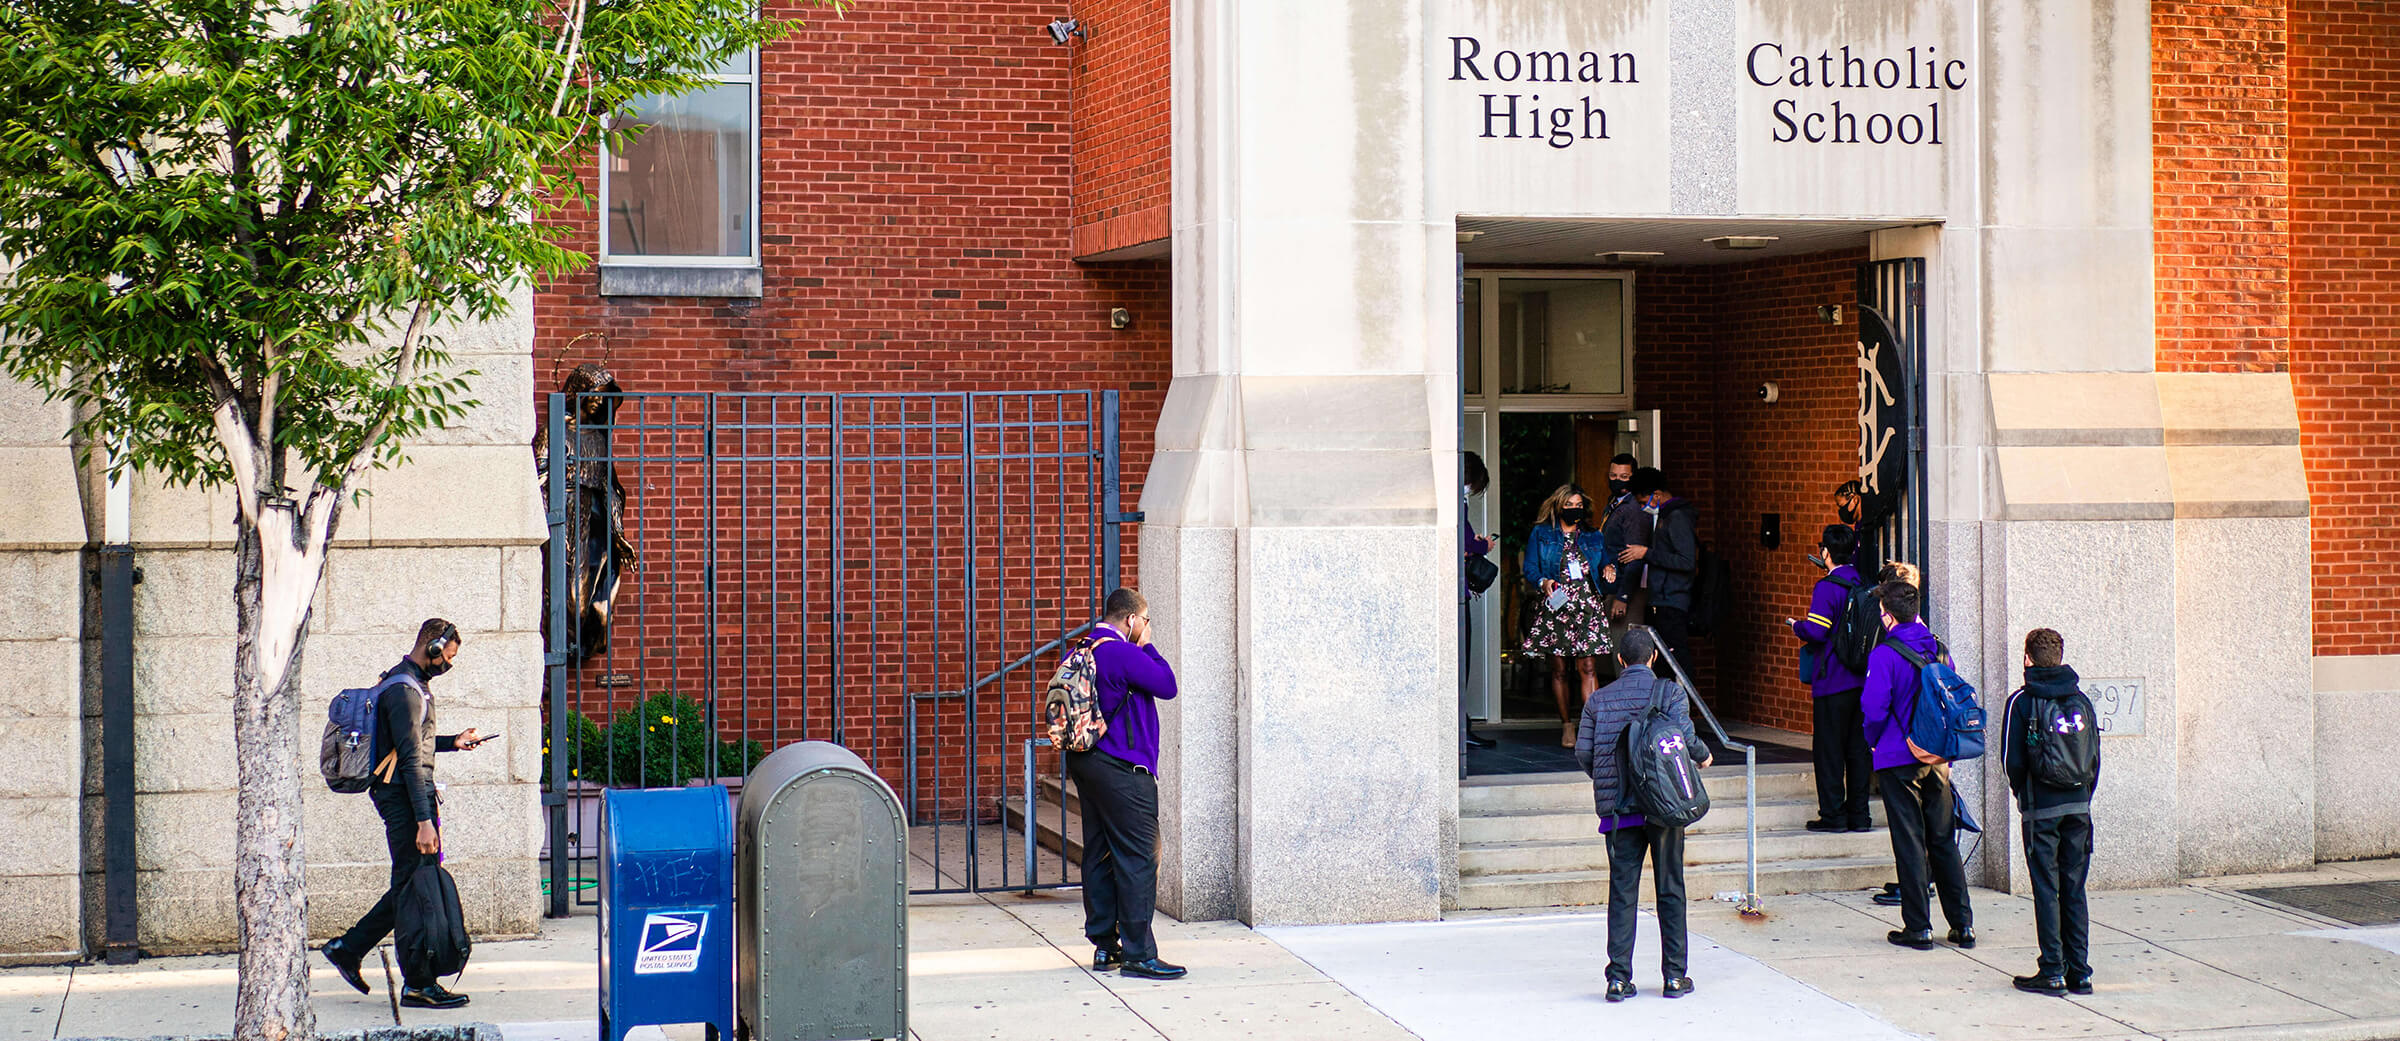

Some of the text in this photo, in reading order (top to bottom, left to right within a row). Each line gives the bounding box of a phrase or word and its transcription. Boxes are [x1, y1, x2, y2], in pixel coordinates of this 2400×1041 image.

[1448, 36, 1968, 91] Roman Catholic
[1478, 94, 1943, 148] High School
